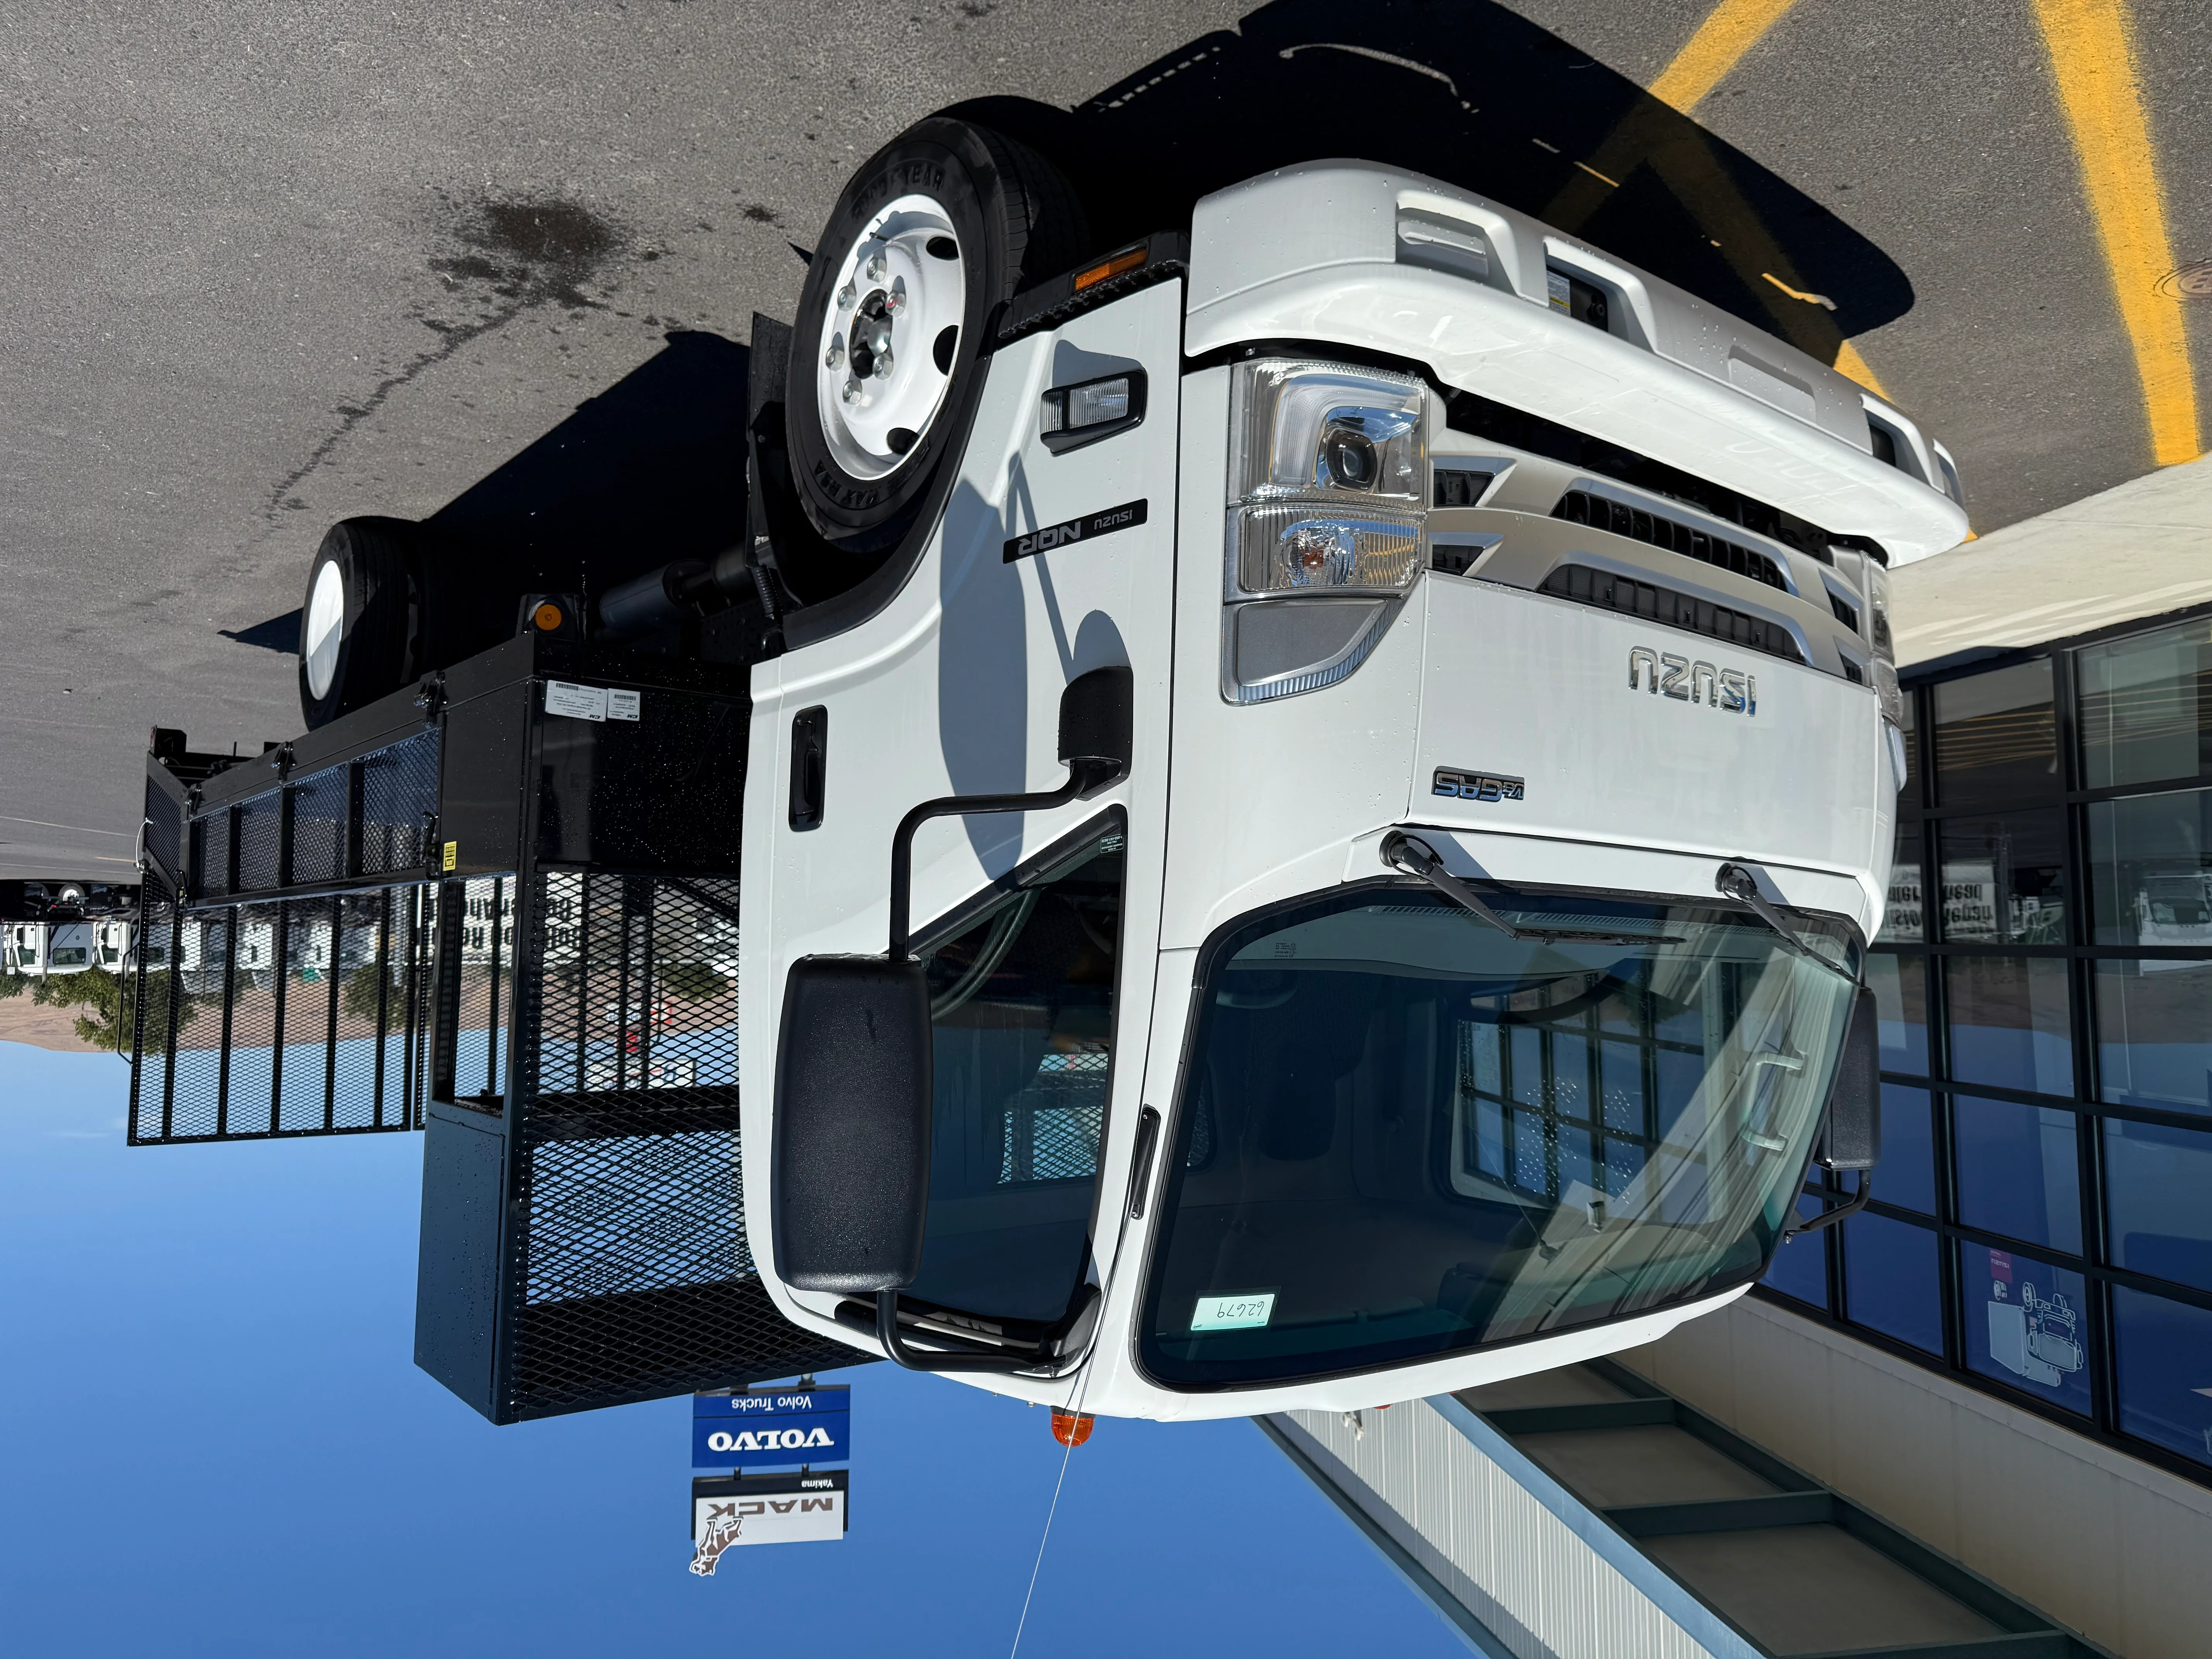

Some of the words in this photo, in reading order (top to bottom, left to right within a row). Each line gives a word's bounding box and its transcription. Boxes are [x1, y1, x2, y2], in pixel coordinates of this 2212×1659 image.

[814, 459, 842, 498] RSA
[839, 486, 881, 506] MAX
[1094, 508, 1133, 531] ISUZU
[1017, 521, 1082, 556] NQR
[1627, 647, 1757, 718] ISUZU
[1434, 772, 1503, 803] GAS
[1991, 1258, 2009, 1269] ISUZU
[1216, 1301, 1265, 1318] 62679
[731, 1397, 774, 1412] Trucks
[777, 1395, 812, 1410] Volvo
[707, 1427, 835, 1452] VOLVO
[801, 1479, 833, 1489] Yakima
[707, 1498, 833, 1518] MACK
